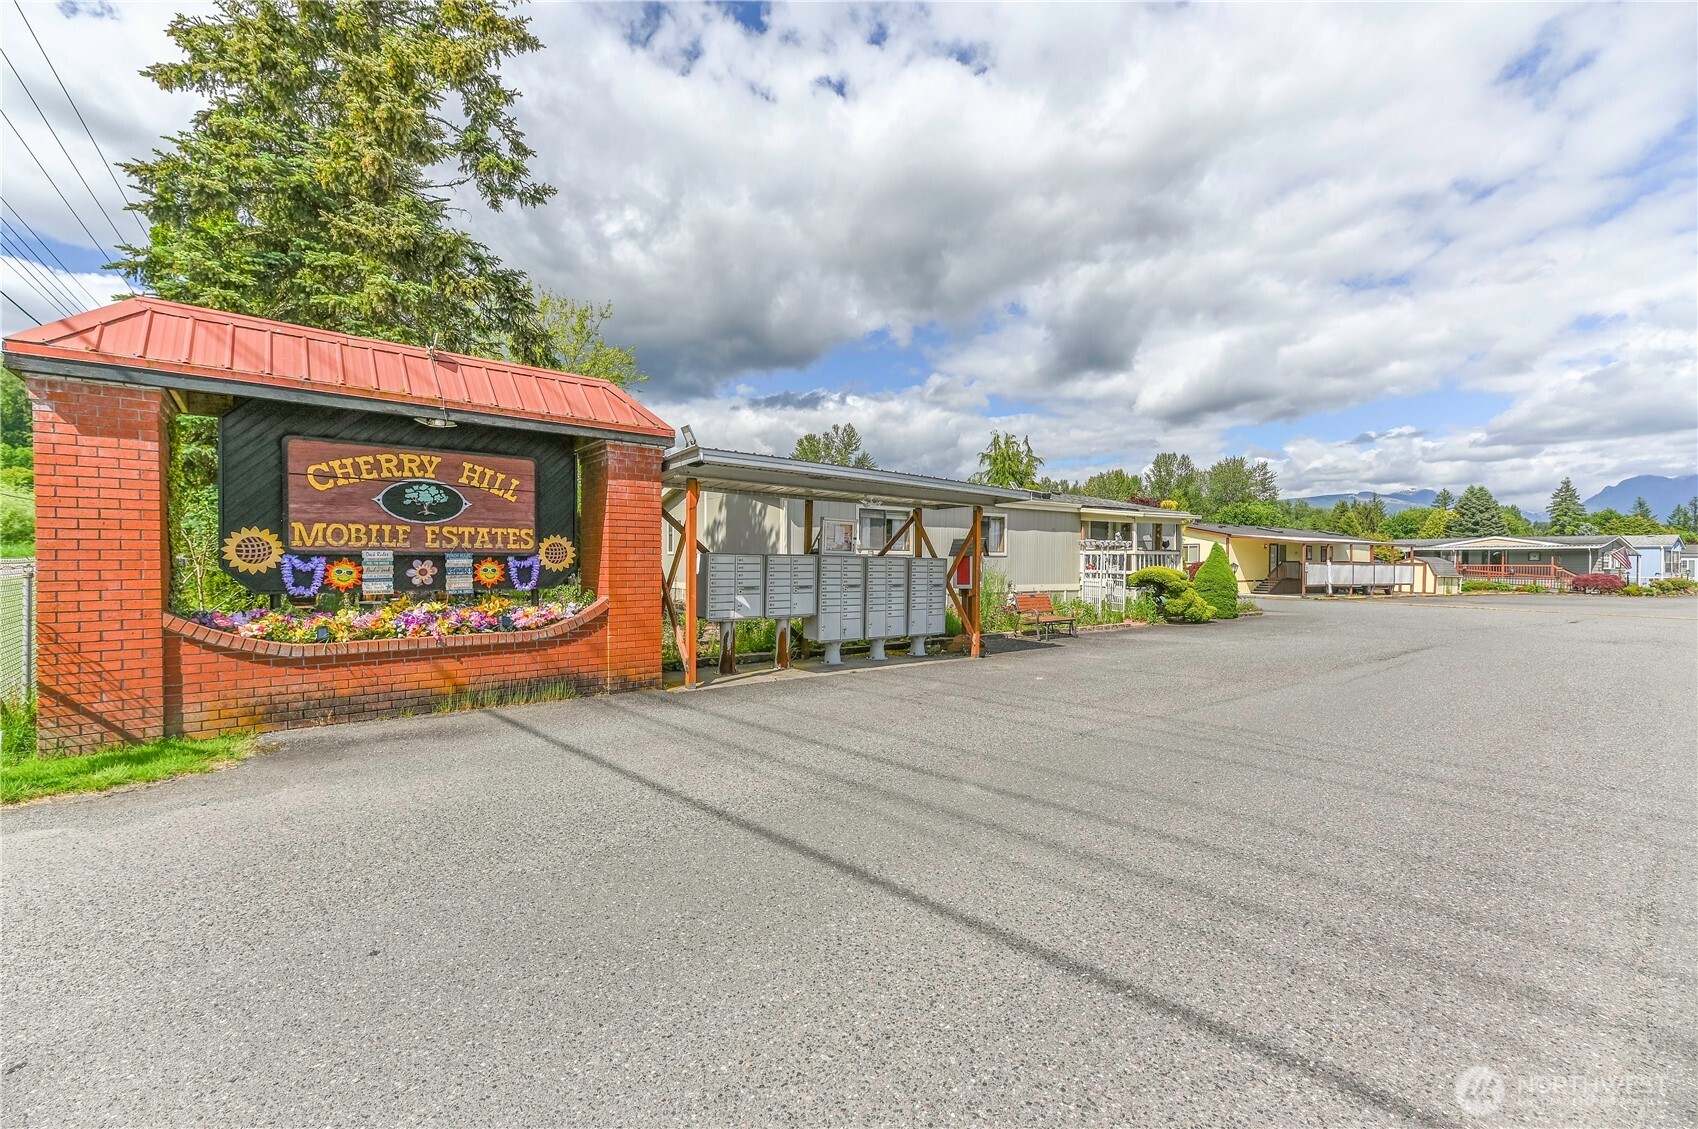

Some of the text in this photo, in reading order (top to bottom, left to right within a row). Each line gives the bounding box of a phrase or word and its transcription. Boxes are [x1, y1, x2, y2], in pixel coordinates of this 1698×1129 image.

[306, 453, 521, 503] CHERRY HILL
[290, 522, 534, 550] MOBILE ESTATES
